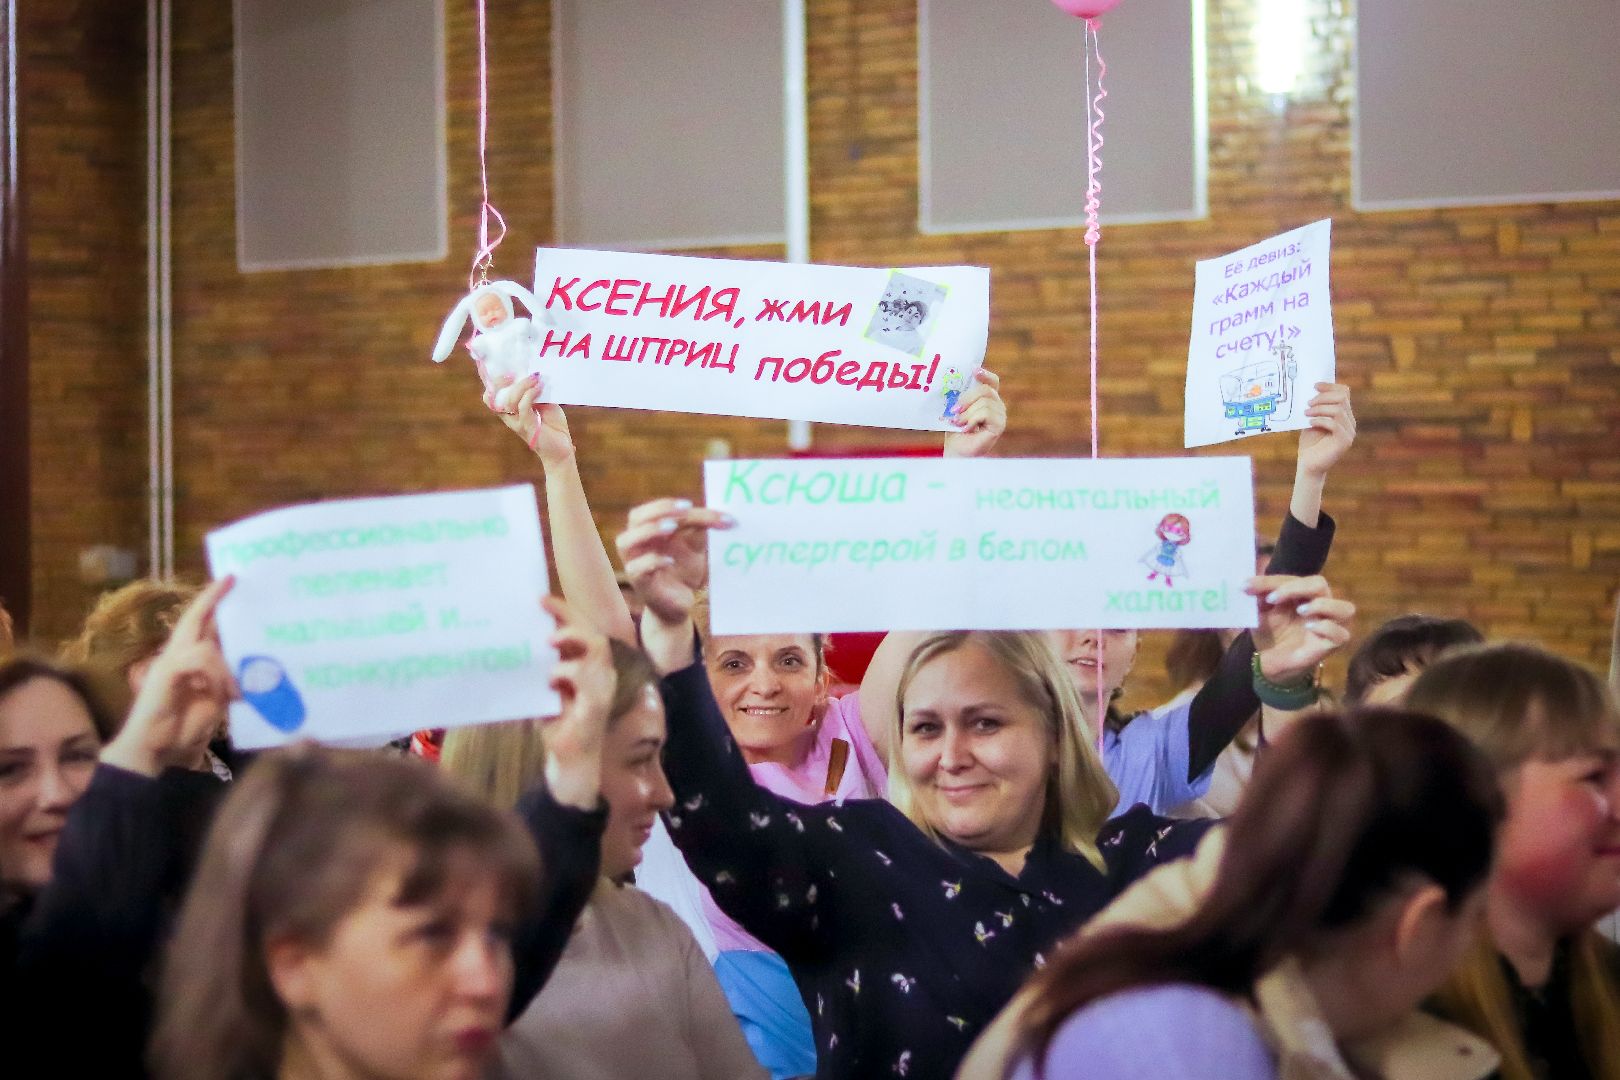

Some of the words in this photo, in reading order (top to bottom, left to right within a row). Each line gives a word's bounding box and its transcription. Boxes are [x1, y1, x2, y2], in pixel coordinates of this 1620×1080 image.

[1212, 257, 1312, 305] «Каждый
[1224, 261, 1243, 279] Её
[1248, 242, 1302, 270] девиз:
[546, 276, 746, 329] КСЕНИЯ,
[755, 298, 853, 327] жми
[1209, 301, 1275, 336] грамм
[1283, 291, 1310, 312] на
[540, 329, 592, 358] НА
[601, 334, 740, 374] ШПРИЦ
[755, 350, 941, 393] победы!
[1215, 323, 1302, 359] счету!»
[723, 461, 909, 505] Ксюша
[976, 481, 1221, 512] неонатальный
[723, 530, 938, 572] супергерой
[948, 538, 969, 561] в
[976, 530, 1088, 562] белом
[1104, 584, 1229, 614] халате!
